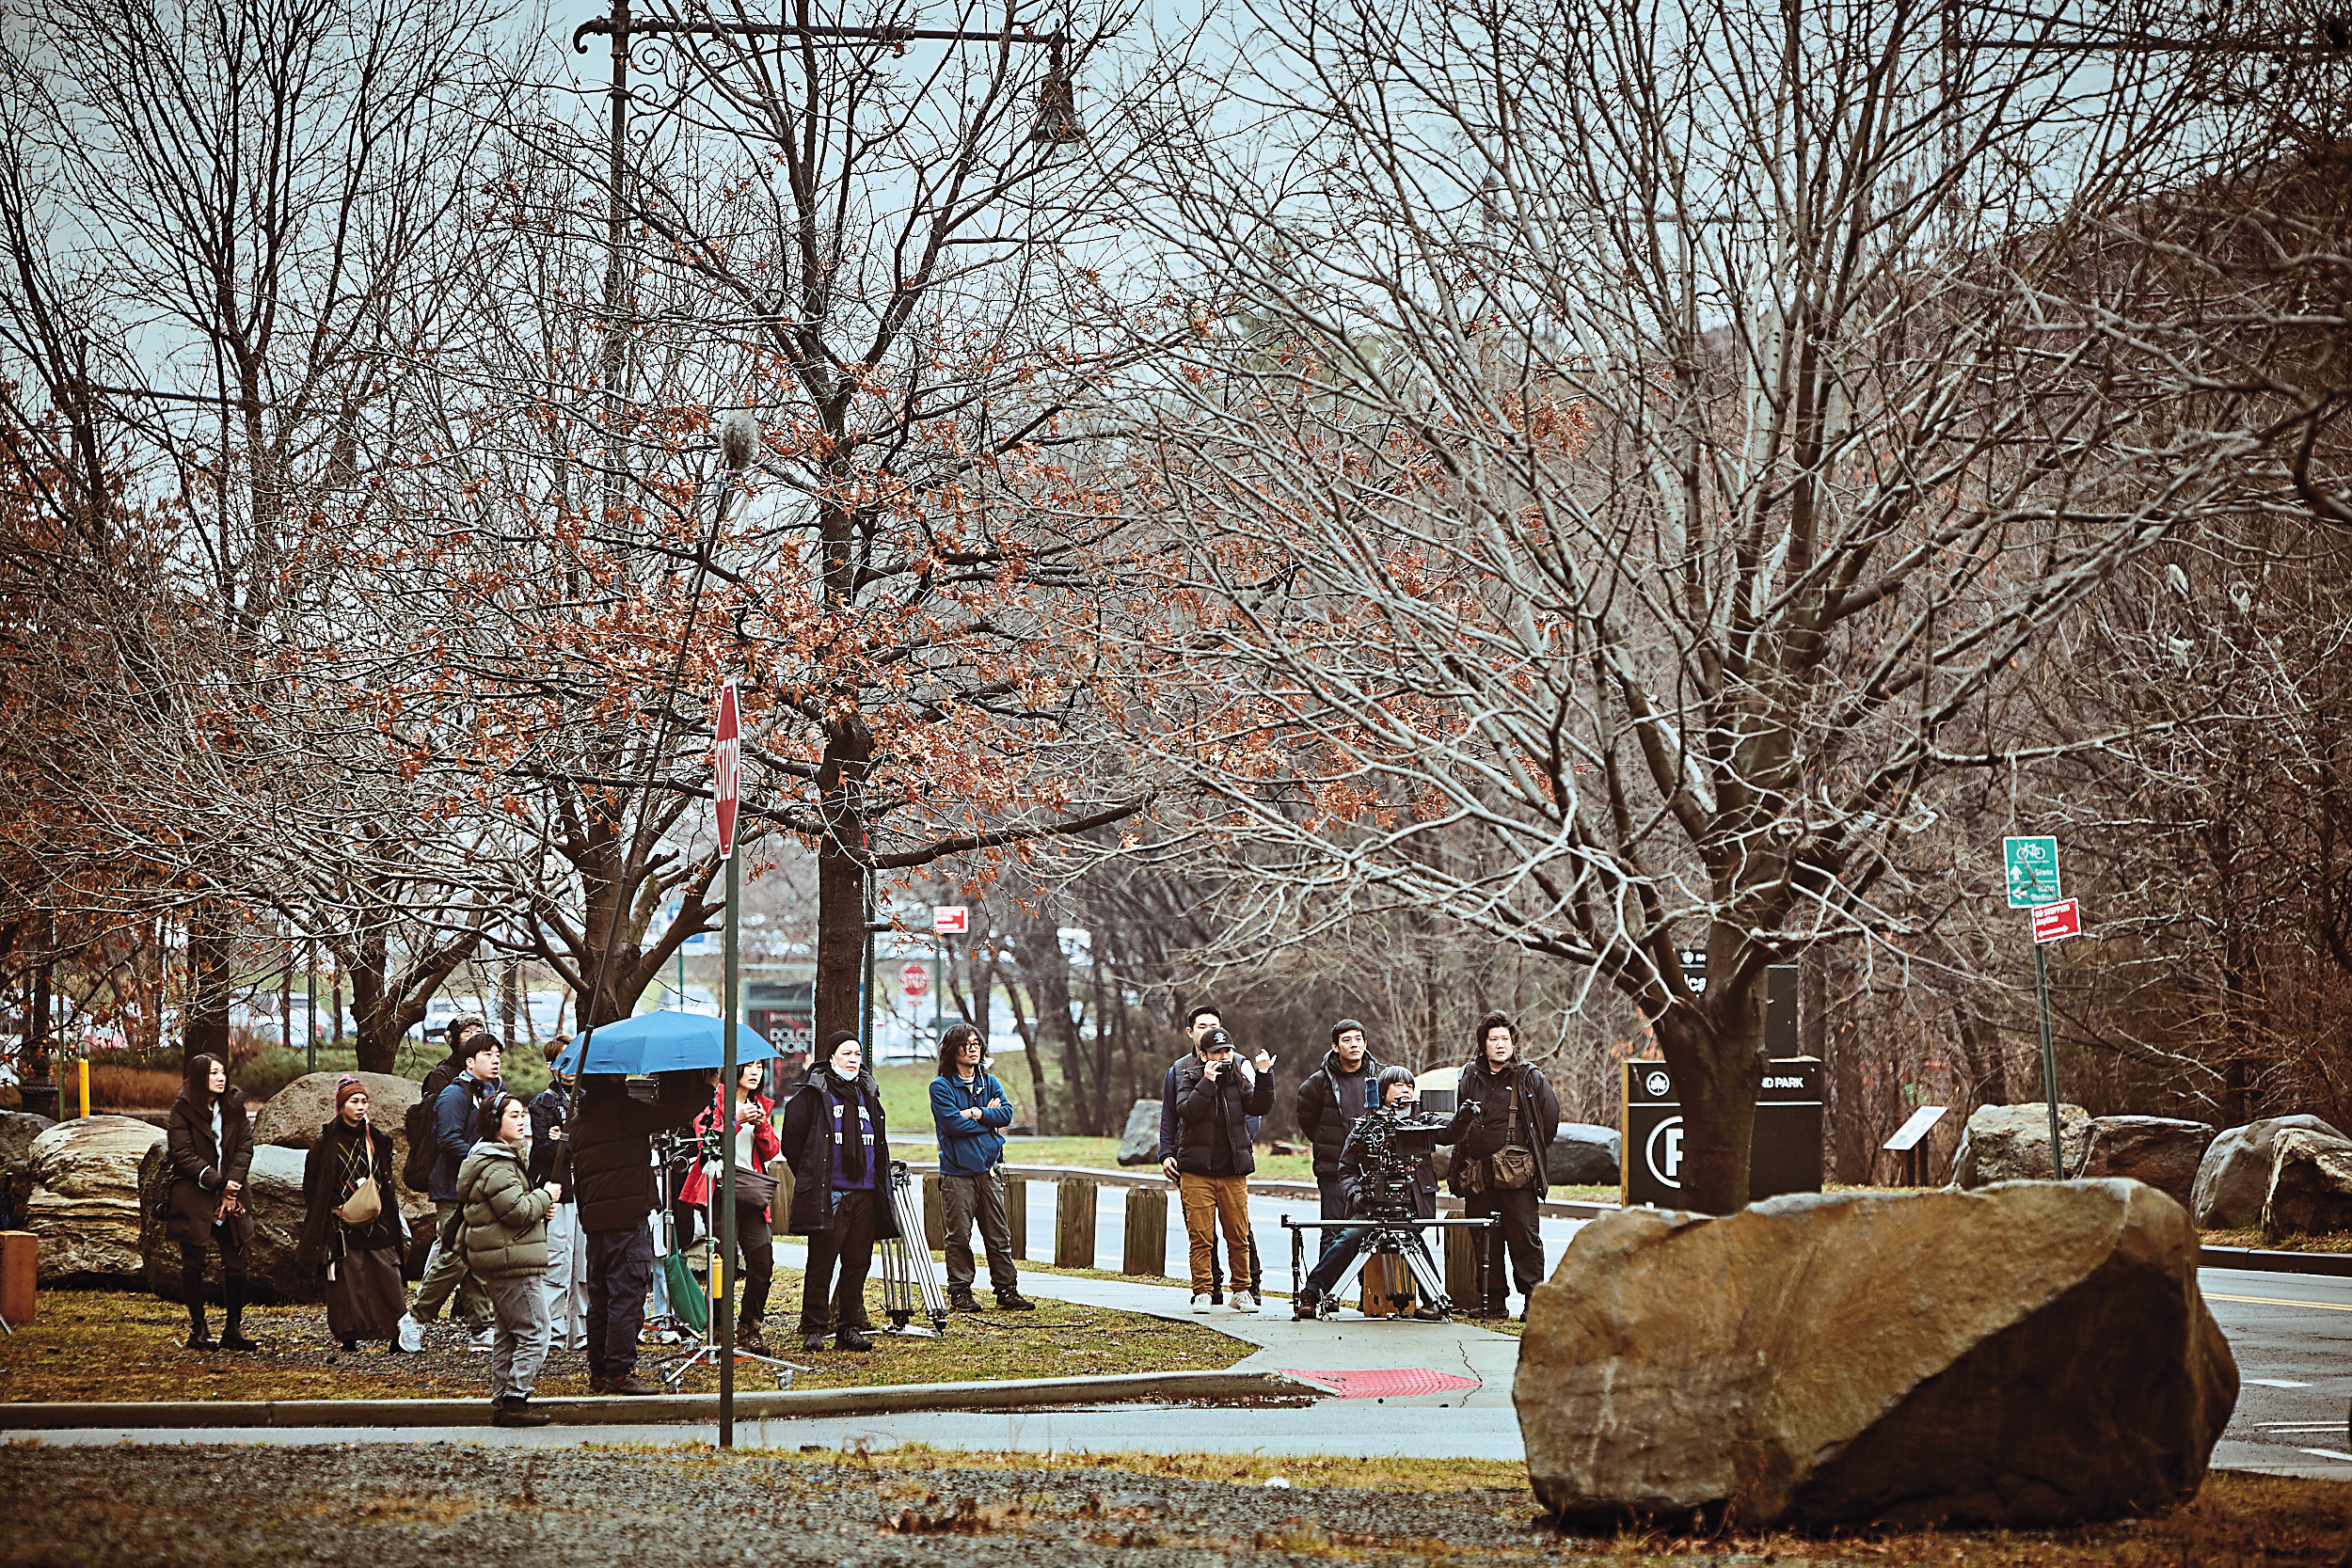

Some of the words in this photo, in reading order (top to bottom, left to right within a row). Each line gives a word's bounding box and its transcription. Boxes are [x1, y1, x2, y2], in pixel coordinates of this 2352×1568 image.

[715, 738, 737, 802] STOP
[2035, 910, 2043, 918] NO
[2043, 904, 2071, 916] STOPPING
[900, 974, 927, 989] STOP
[770, 1027, 813, 1042] DOLCE
[775, 1041, 808, 1054] NOIR
[1774, 1077, 1804, 1088] PARK
